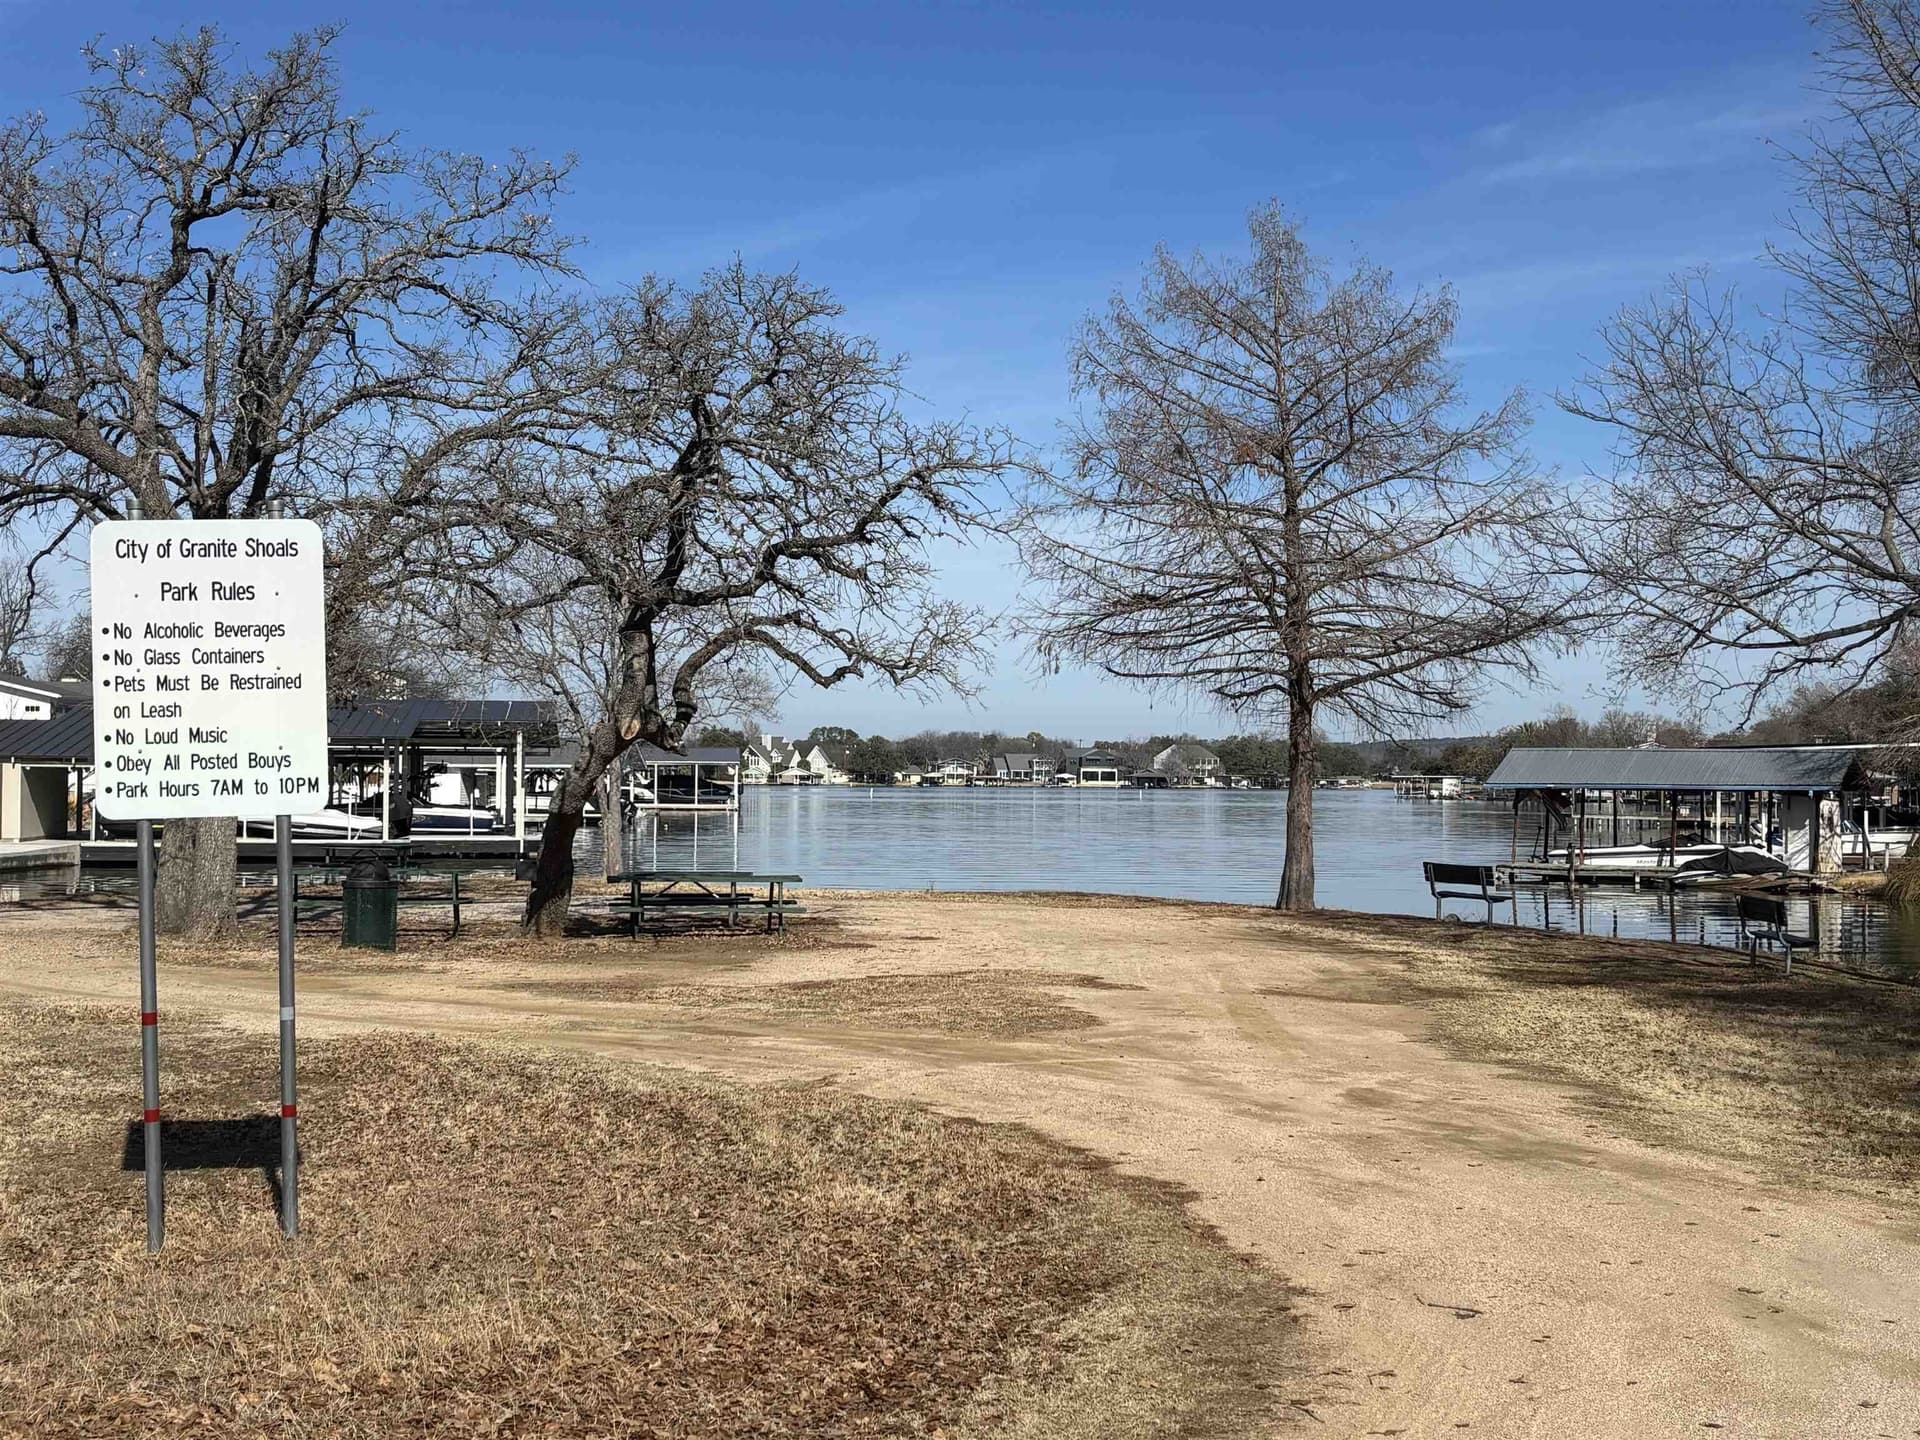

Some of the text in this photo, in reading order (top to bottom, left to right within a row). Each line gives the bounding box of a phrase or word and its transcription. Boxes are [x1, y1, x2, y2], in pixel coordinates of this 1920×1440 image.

[116, 538, 299, 564] City of Granite Shoals
[161, 582, 256, 601] Park Rules
[114, 622, 286, 642] No Alcoholic Beverages
[115, 648, 265, 666] No Glass Containers
[115, 673, 302, 692] Pets Must Be Restrained
[114, 702, 182, 719] on Leash
[116, 728, 228, 745] No Loud Music
[117, 753, 292, 775] Obey All Posted Bouys
[117, 777, 320, 798] Park Hours 7AM to 10PM
